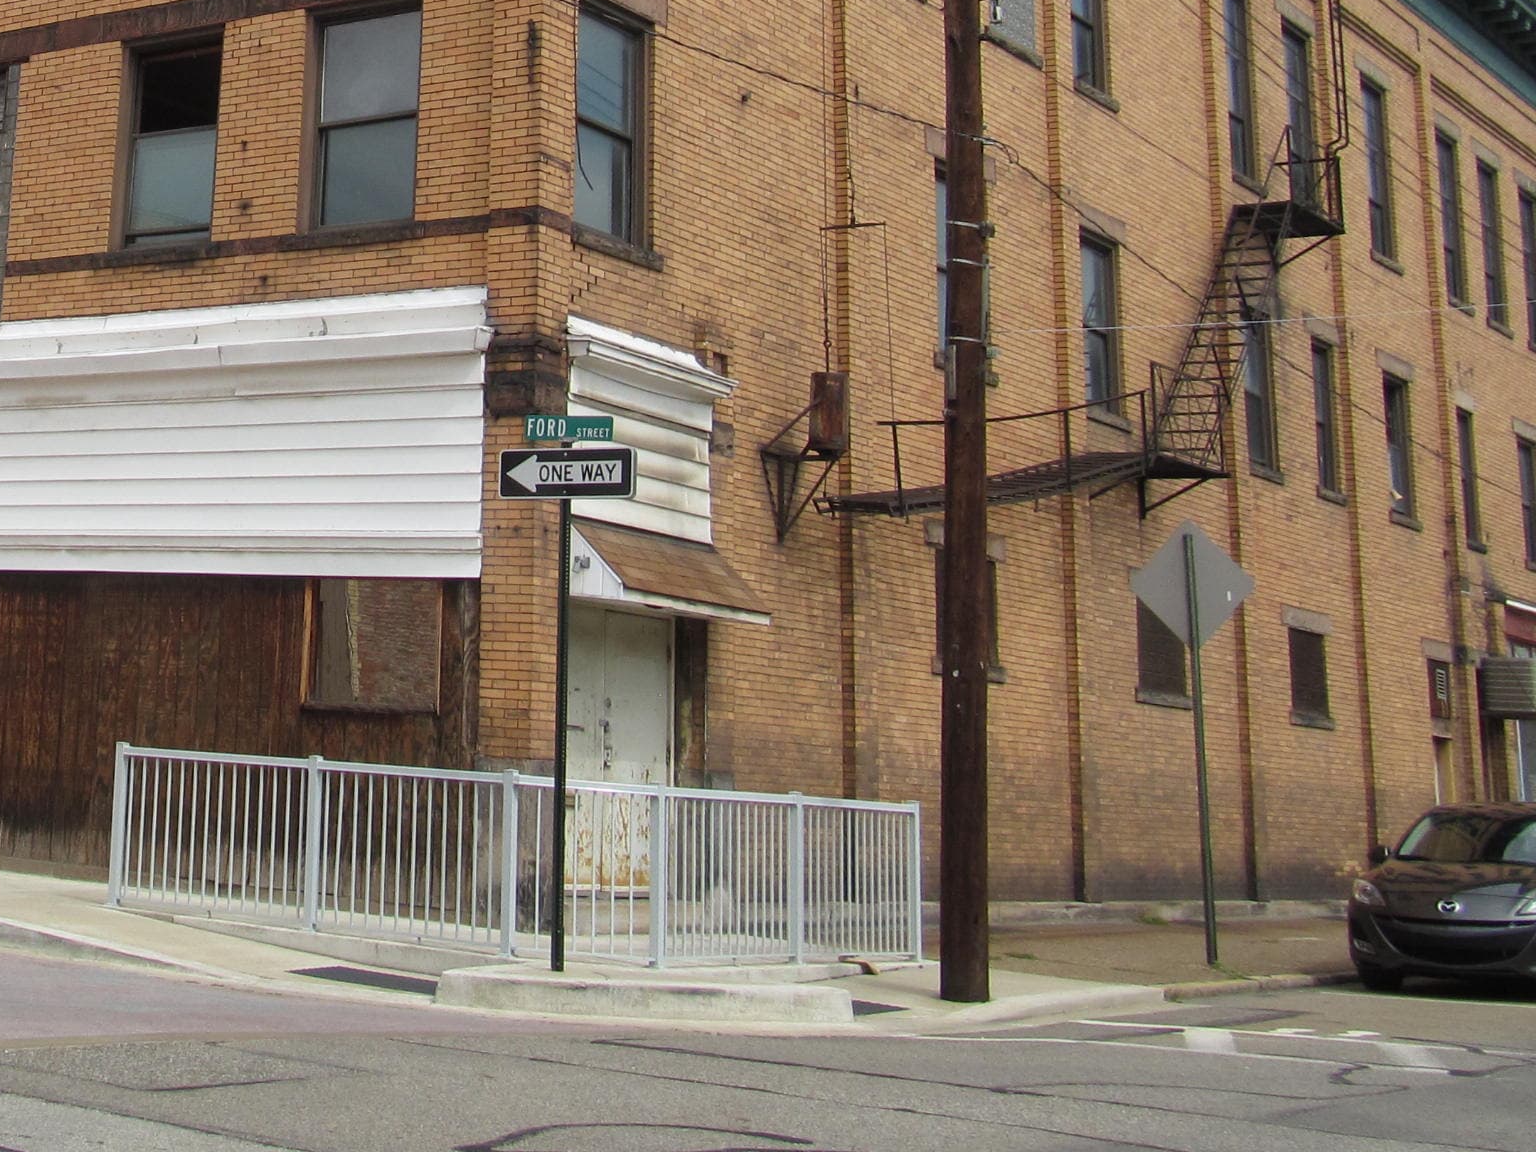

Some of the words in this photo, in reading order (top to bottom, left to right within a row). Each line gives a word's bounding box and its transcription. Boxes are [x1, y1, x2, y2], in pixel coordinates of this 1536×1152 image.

[527, 418, 566, 437] FORD
[576, 428, 610, 438] STREET
[539, 464, 573, 482] ONE
[581, 463, 616, 481] WAY
